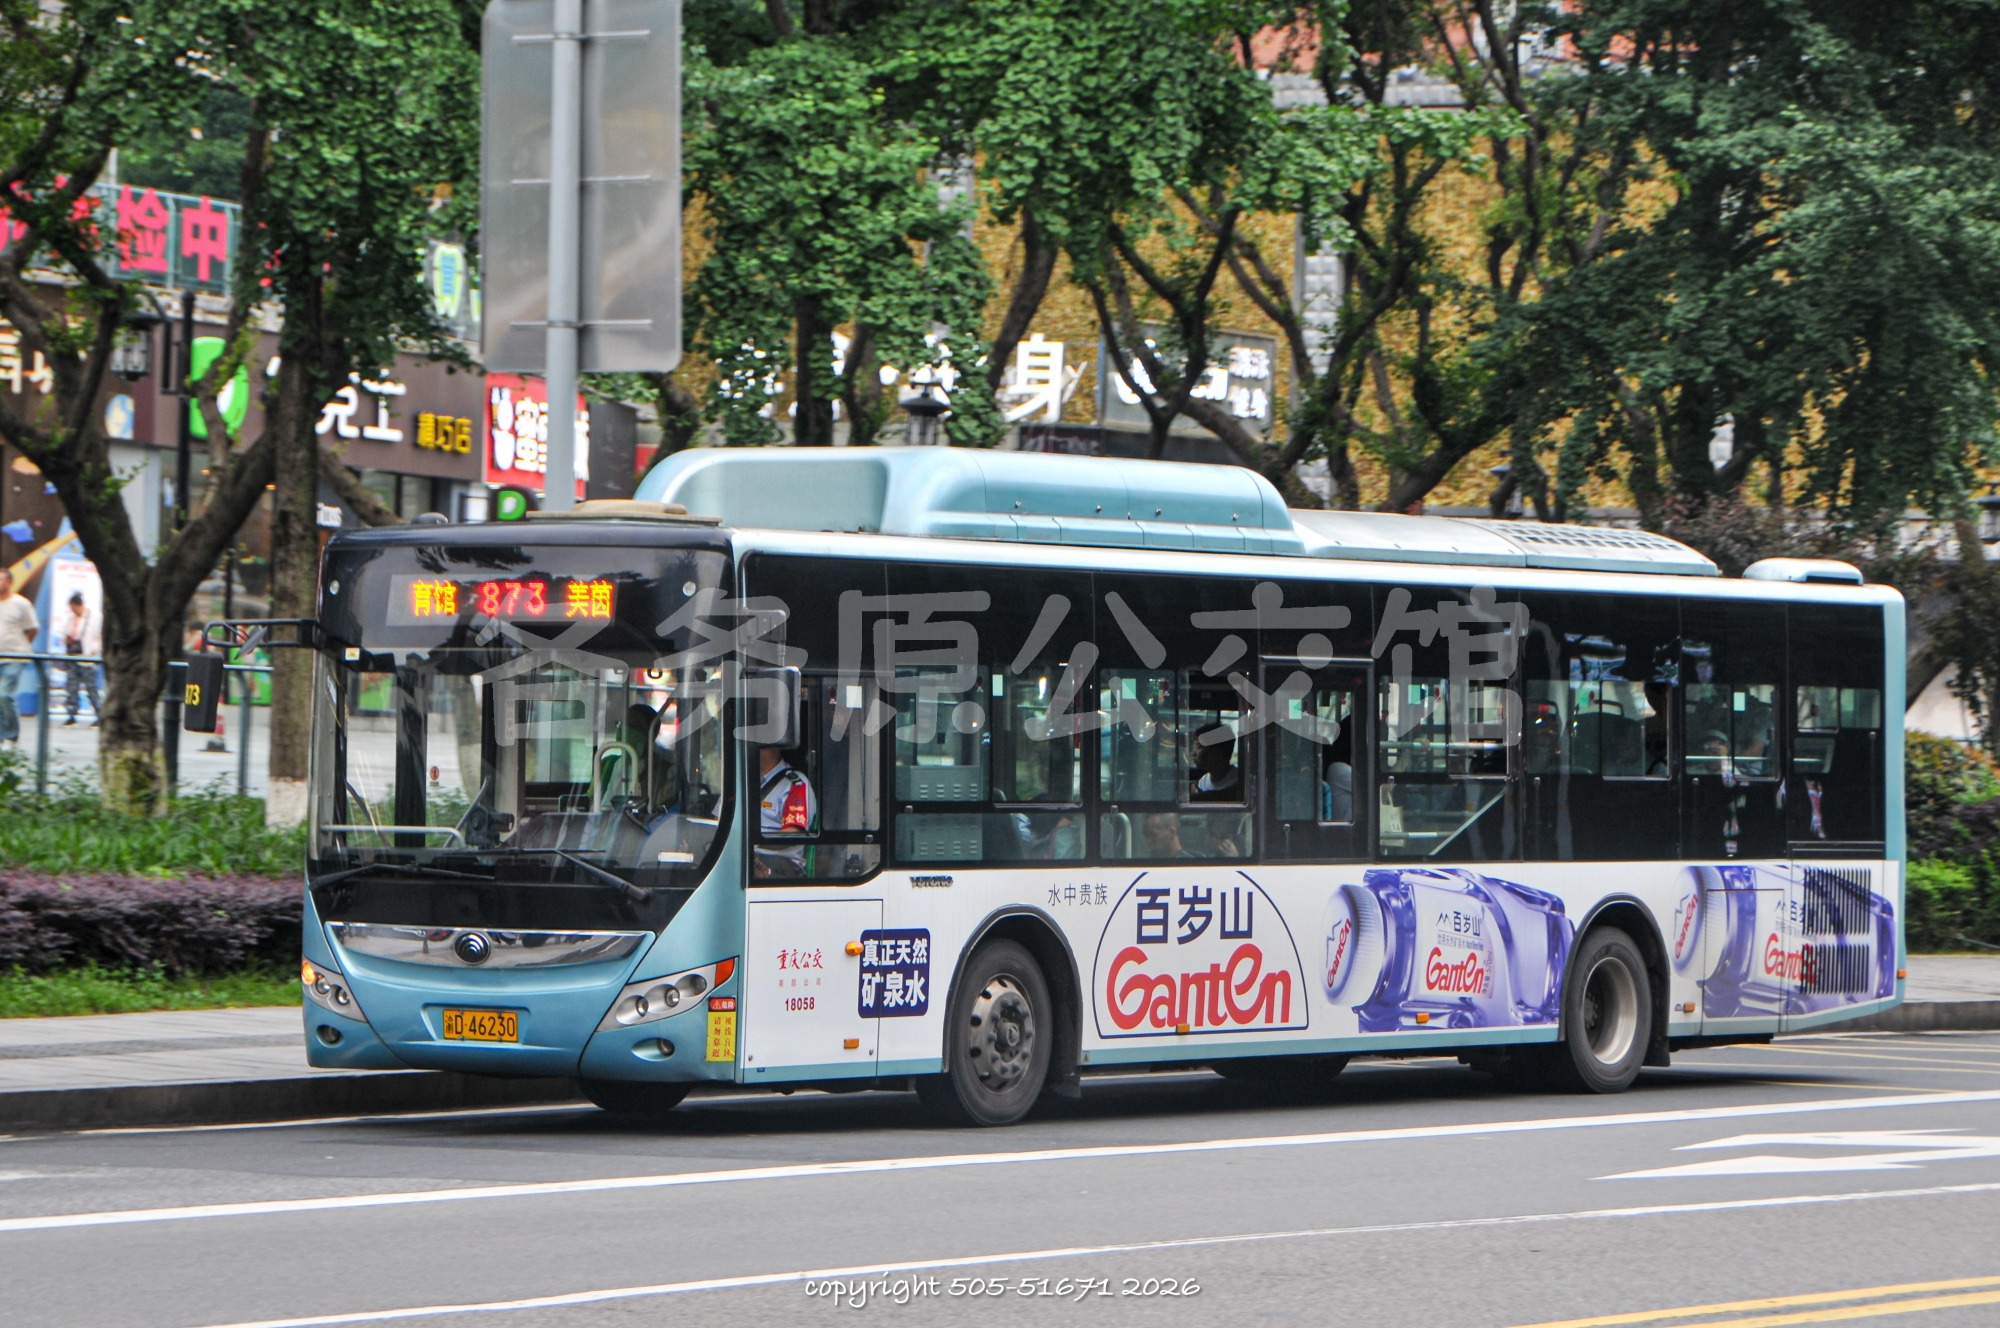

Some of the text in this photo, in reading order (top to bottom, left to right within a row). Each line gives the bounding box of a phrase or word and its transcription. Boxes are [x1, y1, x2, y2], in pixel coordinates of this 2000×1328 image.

[413, 580, 457, 617] 育馆
[482, 581, 546, 616] 873
[566, 580, 613, 618] 美茵
[1047, 883, 1108, 907] 水中贵族
[1135, 885, 1254, 945] 百岁山
[1453, 911, 1480, 936] 百岁山
[776, 948, 824, 970] 重庆公交
[862, 938, 928, 967] 真正天然
[1425, 946, 1484, 994] Ganten
[784, 996, 815, 1012] 18058
[861, 971, 926, 1008] 矿泉水
[1106, 943, 1292, 1030] Ganten
